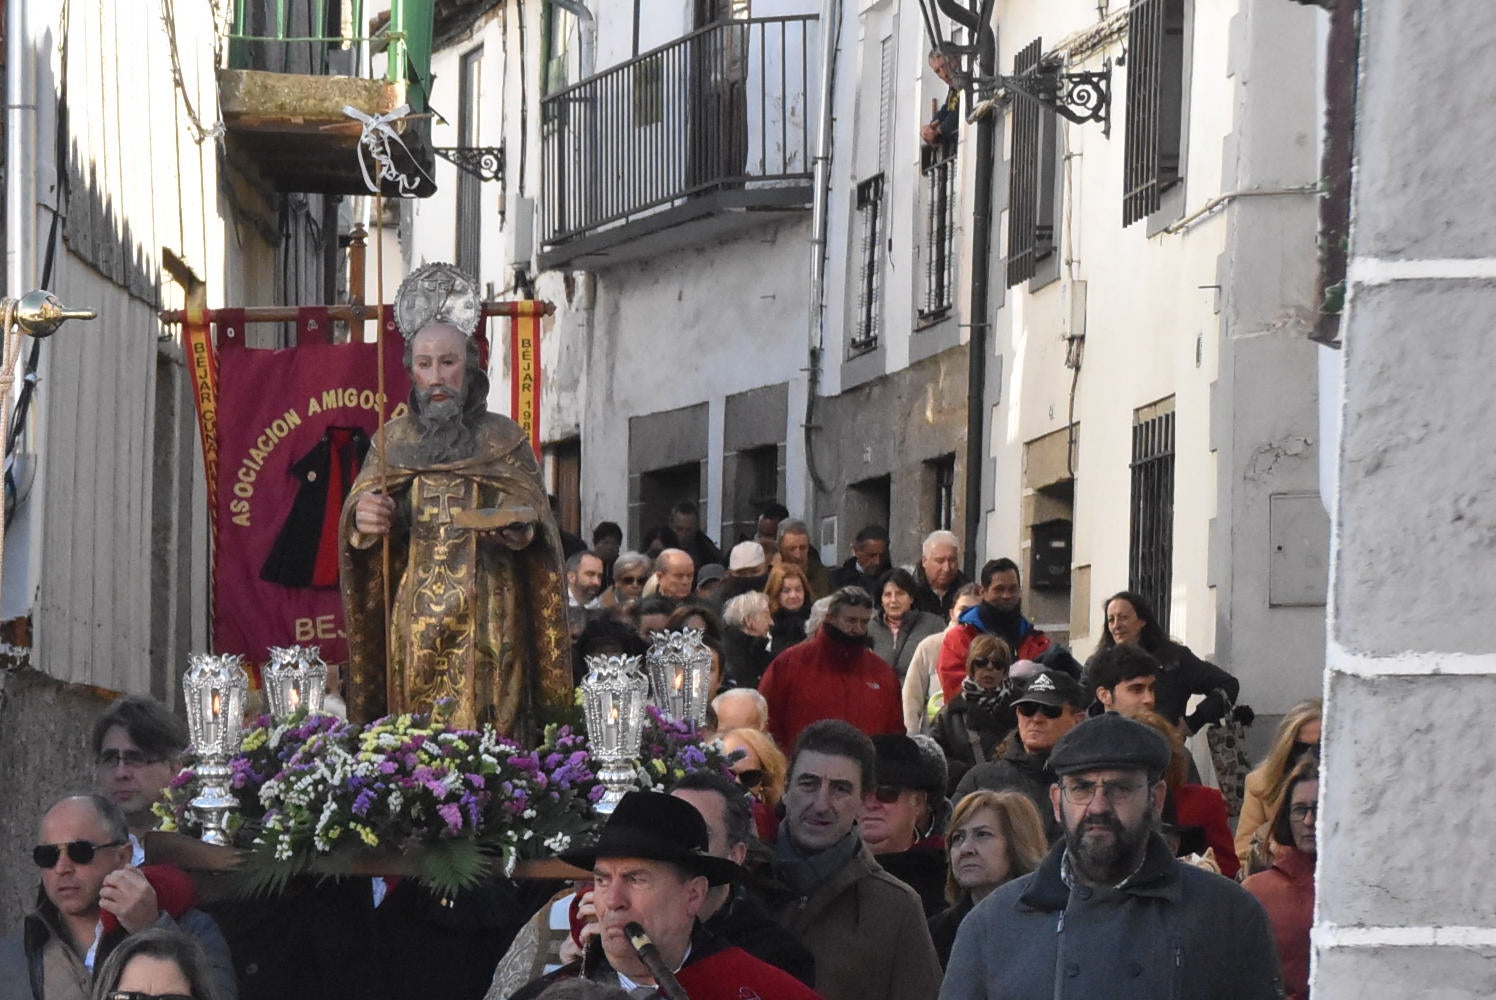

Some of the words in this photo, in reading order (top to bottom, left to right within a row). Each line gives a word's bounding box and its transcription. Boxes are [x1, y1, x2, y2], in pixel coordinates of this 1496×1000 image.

[229, 408, 302, 527] ASOCIACION
[308, 387, 388, 417] AMIGOS
[390, 401, 409, 419] D
[522, 399, 531, 439] 198
